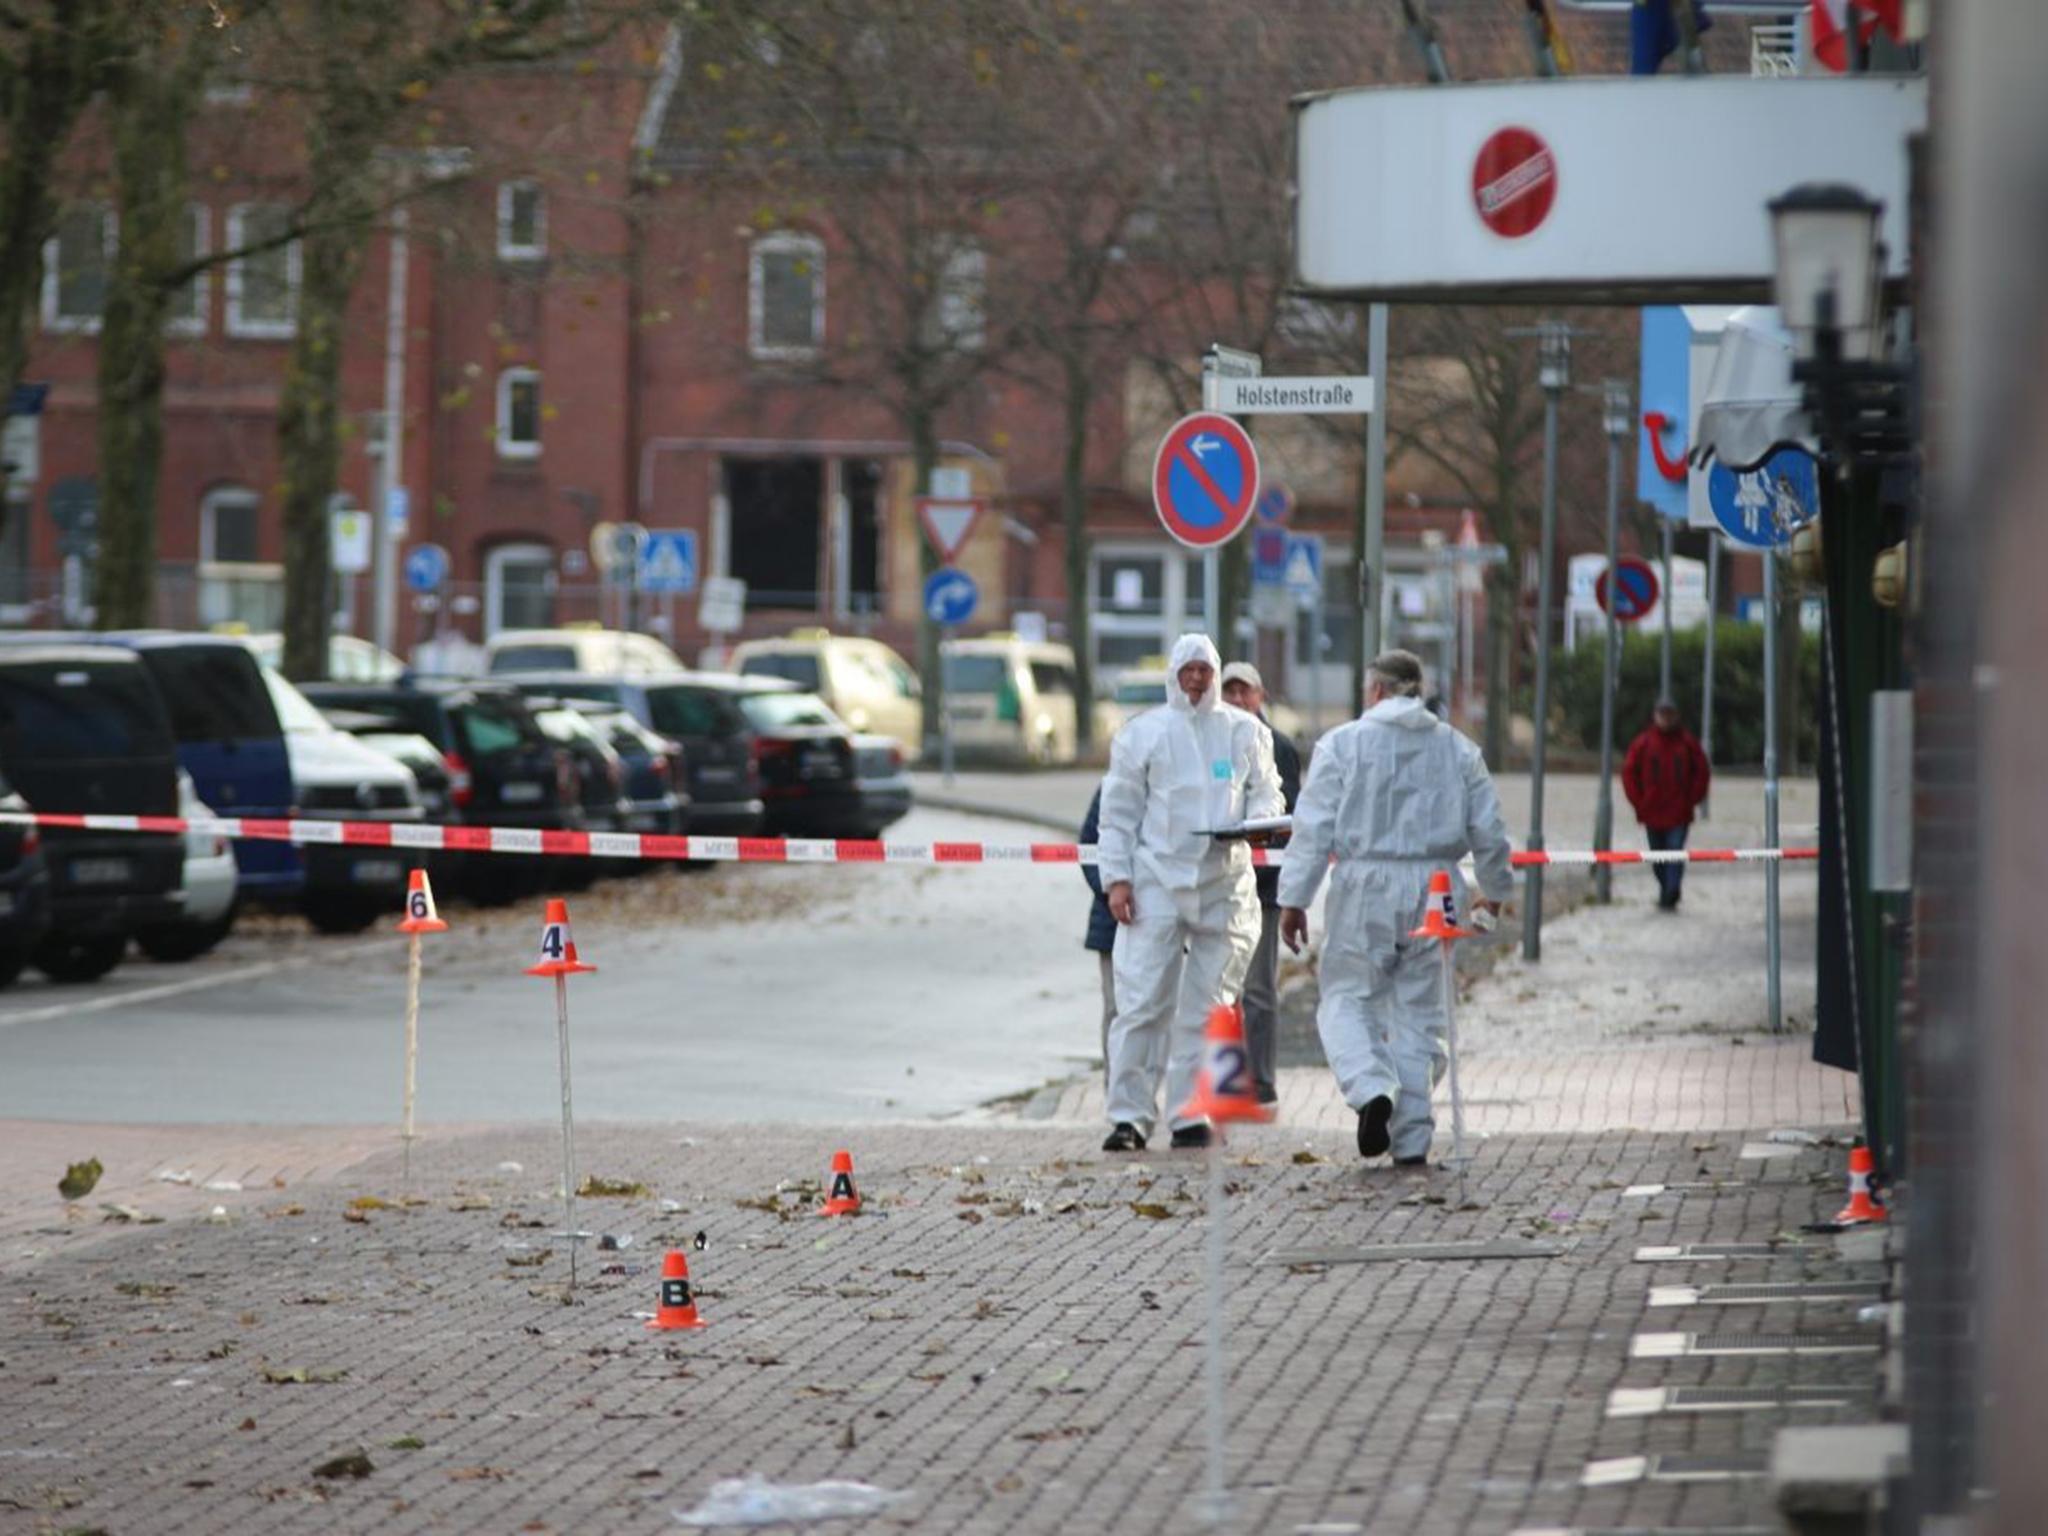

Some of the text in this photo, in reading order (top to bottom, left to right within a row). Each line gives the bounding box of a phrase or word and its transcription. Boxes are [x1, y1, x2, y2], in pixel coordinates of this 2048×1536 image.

[1236, 384, 1354, 406] Holstenstraße
[411, 892, 428, 919] 6
[542, 925, 564, 958] 4
[1215, 1046, 1248, 1096] 2
[831, 1172, 855, 1200] A
[662, 1279, 691, 1308] B
